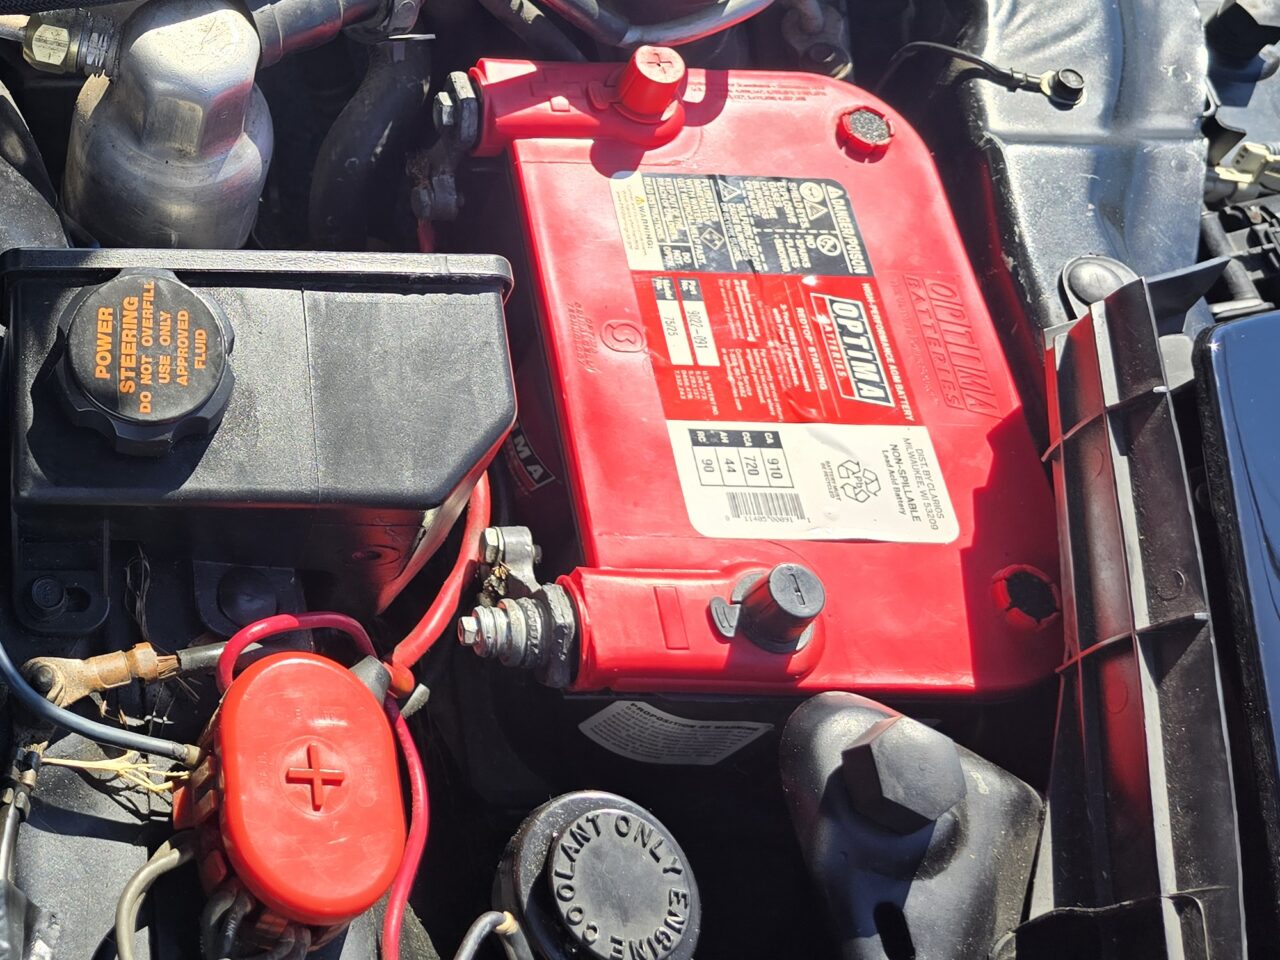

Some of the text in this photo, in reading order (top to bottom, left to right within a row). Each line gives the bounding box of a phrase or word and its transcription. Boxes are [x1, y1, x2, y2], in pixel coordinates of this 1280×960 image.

[776, 181, 798, 223] EXPLOSIVE
[788, 182, 804, 207] SHIELD
[637, 205, 654, 248] WARNING:
[804, 235, 817, 248] NO
[831, 198, 867, 273] DANGER/POISON
[783, 239, 801, 267] FLAMES
[794, 239, 811, 267] SPARKS
[94, 306, 114, 381] POWER
[119, 295, 140, 395] STEERING
[139, 279, 156, 414] DO NOT OVERFILL
[158, 309, 173, 385] USE ONLY
[175, 308, 191, 387] APPROVED
[194, 328, 208, 370] FLUID
[663, 316, 678, 336] 75/25
[686, 310, 708, 348] 9022-091
[785, 327, 798, 345] FREE
[830, 302, 885, 397] OPTIMA
[907, 276, 960, 406] BATTERIES
[929, 280, 998, 412] OPTIMA
[791, 346, 811, 392] Replacement
[807, 346, 828, 390] STARTING
[861, 283, 914, 420] HIGH-PERFORMANCE AGM BATTERY
[695, 430, 715, 472] RC 90
[718, 431, 737, 472] AH 44
[740, 431, 760, 475] CCA 720
[763, 432, 784, 479] CA 910
[852, 475, 864, 488] Pb
[881, 449, 907, 515] Lead Acid Battery
[888, 443, 922, 522] NON-SPILLABLE
[902, 437, 939, 530] MILWAUKEE, WI 53209
[914, 448, 944, 519] DIST. BY CLARIOS
[629, 702, 697, 729] PROPOSITION
[613, 814, 684, 877] ONLY
[551, 814, 603, 945] COOLANT
[608, 886, 690, 960] ENGINE
